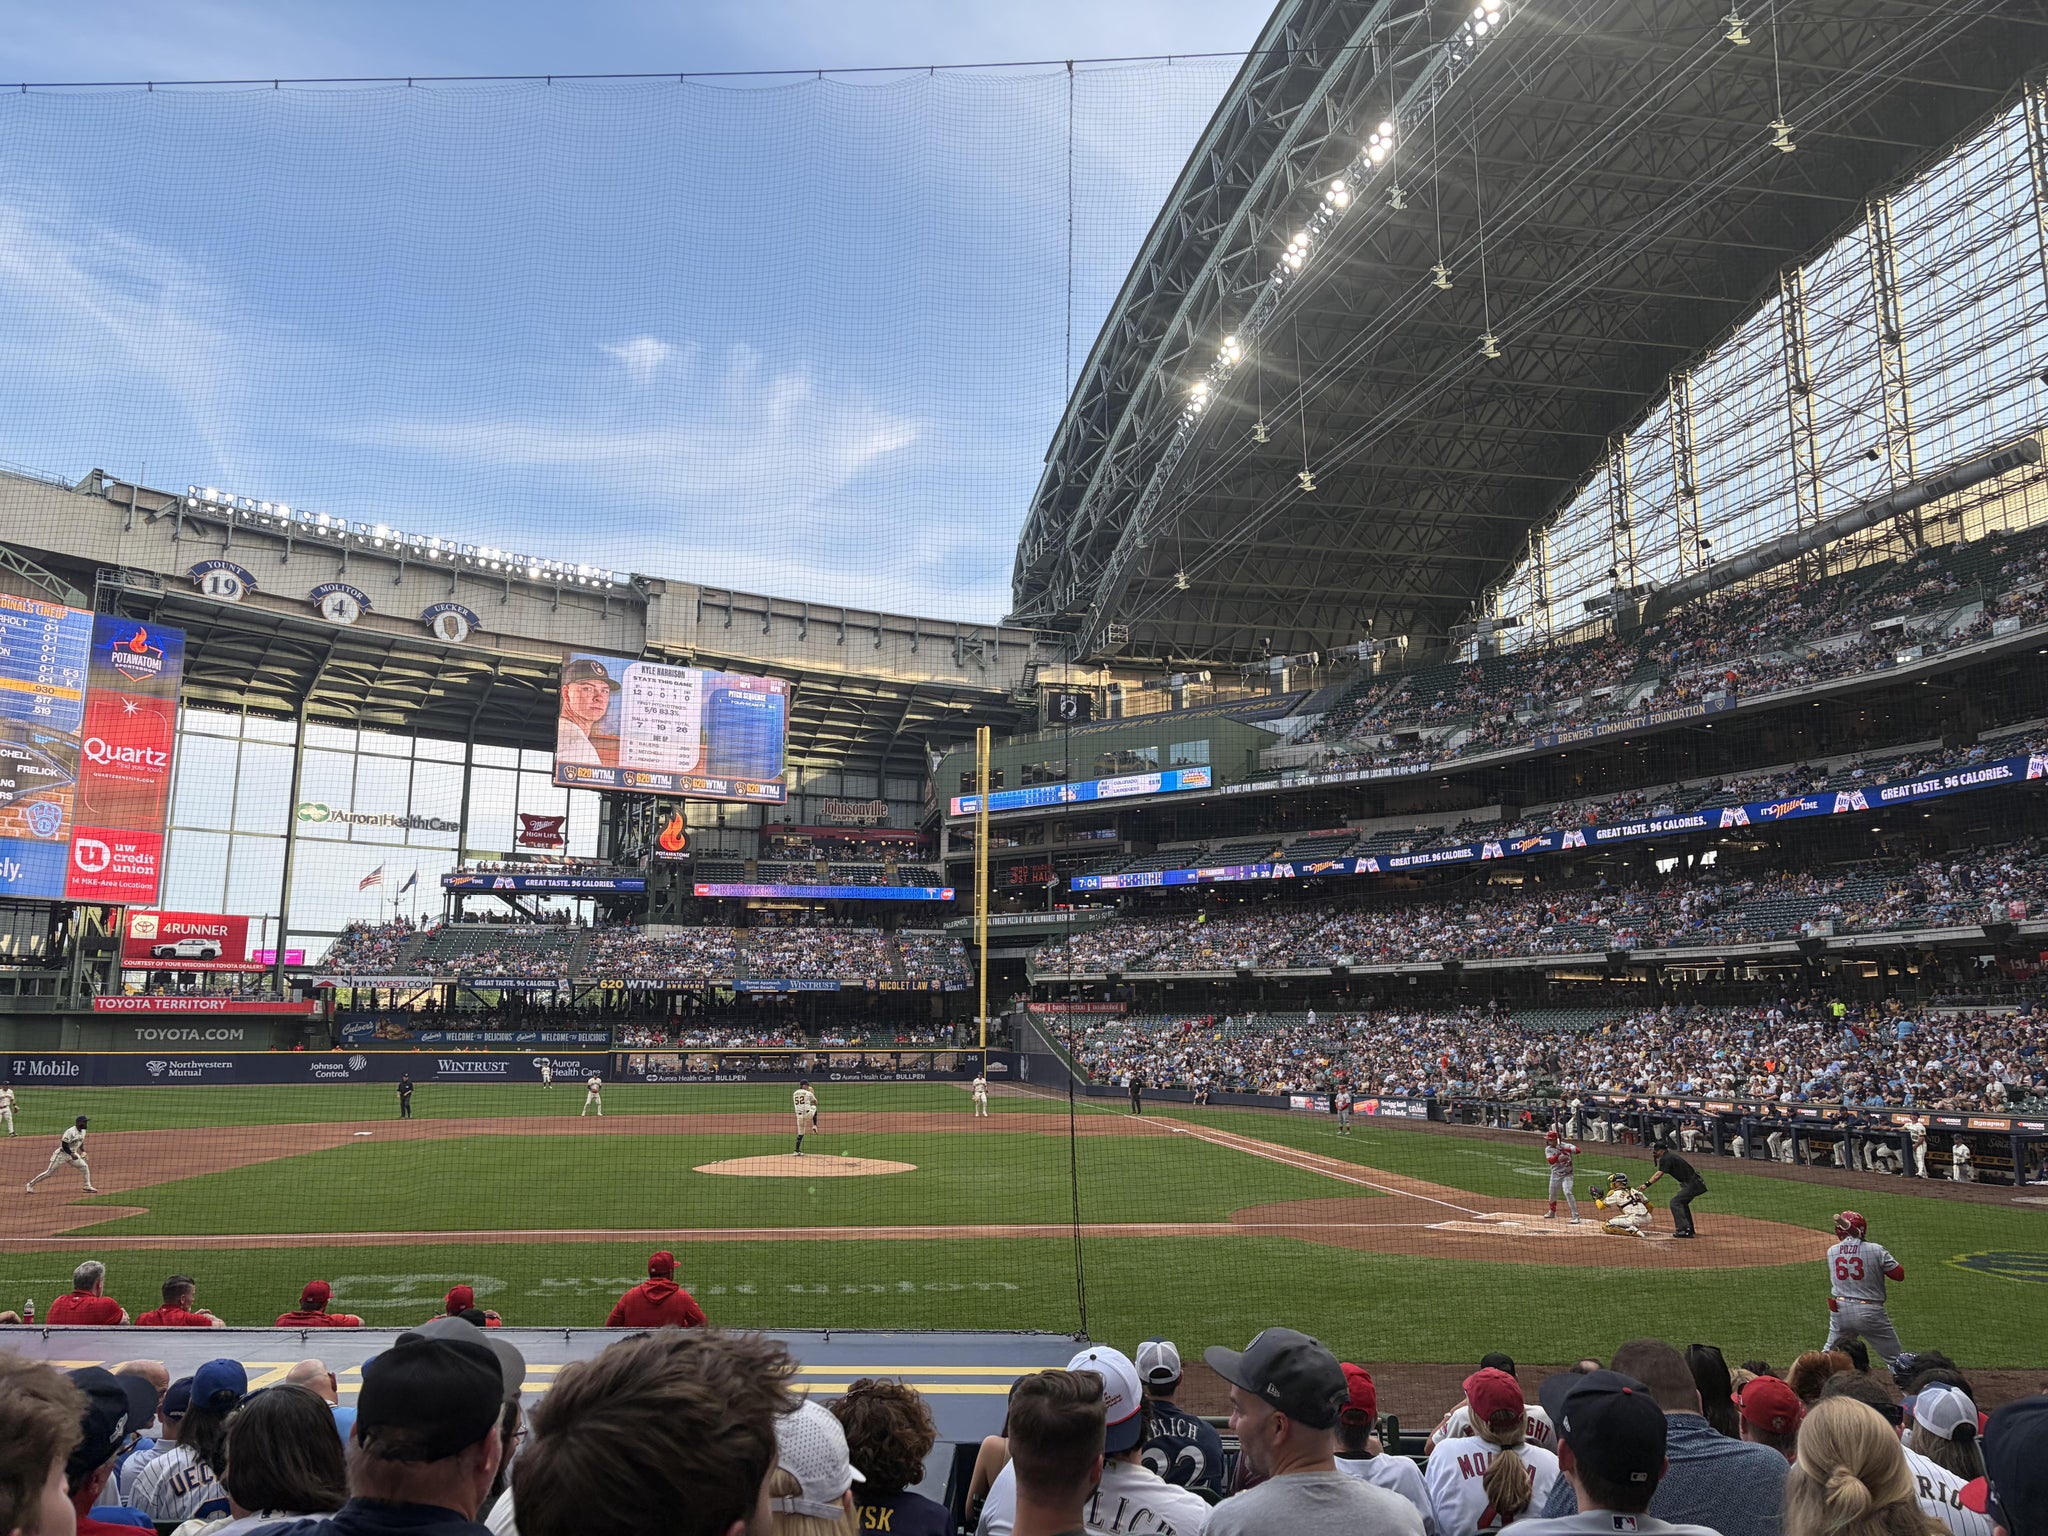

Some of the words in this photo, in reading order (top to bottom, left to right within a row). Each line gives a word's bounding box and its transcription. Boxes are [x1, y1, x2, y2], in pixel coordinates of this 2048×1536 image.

[207, 562, 244, 576] YOUNT
[210, 576, 240, 597] 19
[319, 584, 363, 600] MOLITOR
[35, 605, 69, 620] LINEUP
[332, 599, 347, 617] 4
[434, 604, 469, 617] UECKER
[111, 651, 162, 671] POTAWATOMI
[641, 665, 656, 676] KYLE
[633, 675, 657, 683] STATS
[1558, 729, 1594, 743] BREWERS
[1597, 717, 1647, 736] COMMUNITY
[1650, 704, 1706, 725] FOUNDATION
[83, 737, 167, 767] Quartz
[16, 764, 58, 777] FRELICK
[1881, 787, 1910, 801] GREAT
[1911, 782, 1944, 796] TASTE.
[1944, 776, 1959, 789] 96
[1960, 765, 2013, 786] CALORIES.
[822, 799, 888, 817] Johnsonville
[1771, 797, 1805, 818] Miller
[1801, 800, 1818, 811] TIME
[333, 810, 379, 825] Aurora
[383, 813, 426, 830] Health
[429, 817, 460, 832] Care
[1596, 826, 1622, 840] GREAT
[1623, 823, 1649, 837] TASTE.
[1650, 821, 1662, 833] 96
[1663, 815, 1707, 831] CALORIES.
[114, 843, 137, 852] uw
[1518, 835, 1543, 852] Miller
[113, 853, 155, 865] credit
[1390, 856, 1411, 868] GREAT
[1412, 854, 1432, 866] TASTE.
[1432, 852, 1442, 862] 96
[1441, 848, 1474, 861] CALORIES.
[112, 863, 154, 876] union
[1311, 861, 1336, 874] Miller
[118, 882, 154, 890] Locations
[525, 879, 547, 887] GREAT
[582, 880, 616, 888] CALORIES.
[1078, 878, 1098, 888] 7:04
[162, 922, 229, 937] 4RUNNER
[123, 959, 155, 967] COURTESY
[600, 980, 624, 989] 620
[626, 980, 664, 989] WTMJ
[789, 980, 835, 990] WINTRUST
[879, 981, 910, 991] NICOLET
[912, 981, 929, 990] LAW
[98, 999, 151, 1010] TOYOTA
[154, 999, 227, 1010] TERRITORY
[135, 1028, 245, 1041] TOYOTA.COM
[446, 1033, 474, 1041] WELCOME
[484, 1032, 513, 1041] DELICIOUS
[541, 1033, 569, 1041] WELCOME
[578, 1033, 606, 1041] DELICIOUS
[28, 1060, 80, 1077] Mobile
[168, 1060, 233, 1069] Northwestern
[309, 1062, 343, 1071] Johnson
[437, 1059, 506, 1071] WINTRUST
[551, 1059, 580, 1068] Aurora
[167, 1068, 202, 1077] Mutual
[315, 1070, 350, 1078] Controls
[550, 1068, 579, 1077] Health
[794, 1095, 805, 1105] 52
[1835, 1256, 1865, 1281] 63
[1147, 1417, 1199, 1442] ELICH
